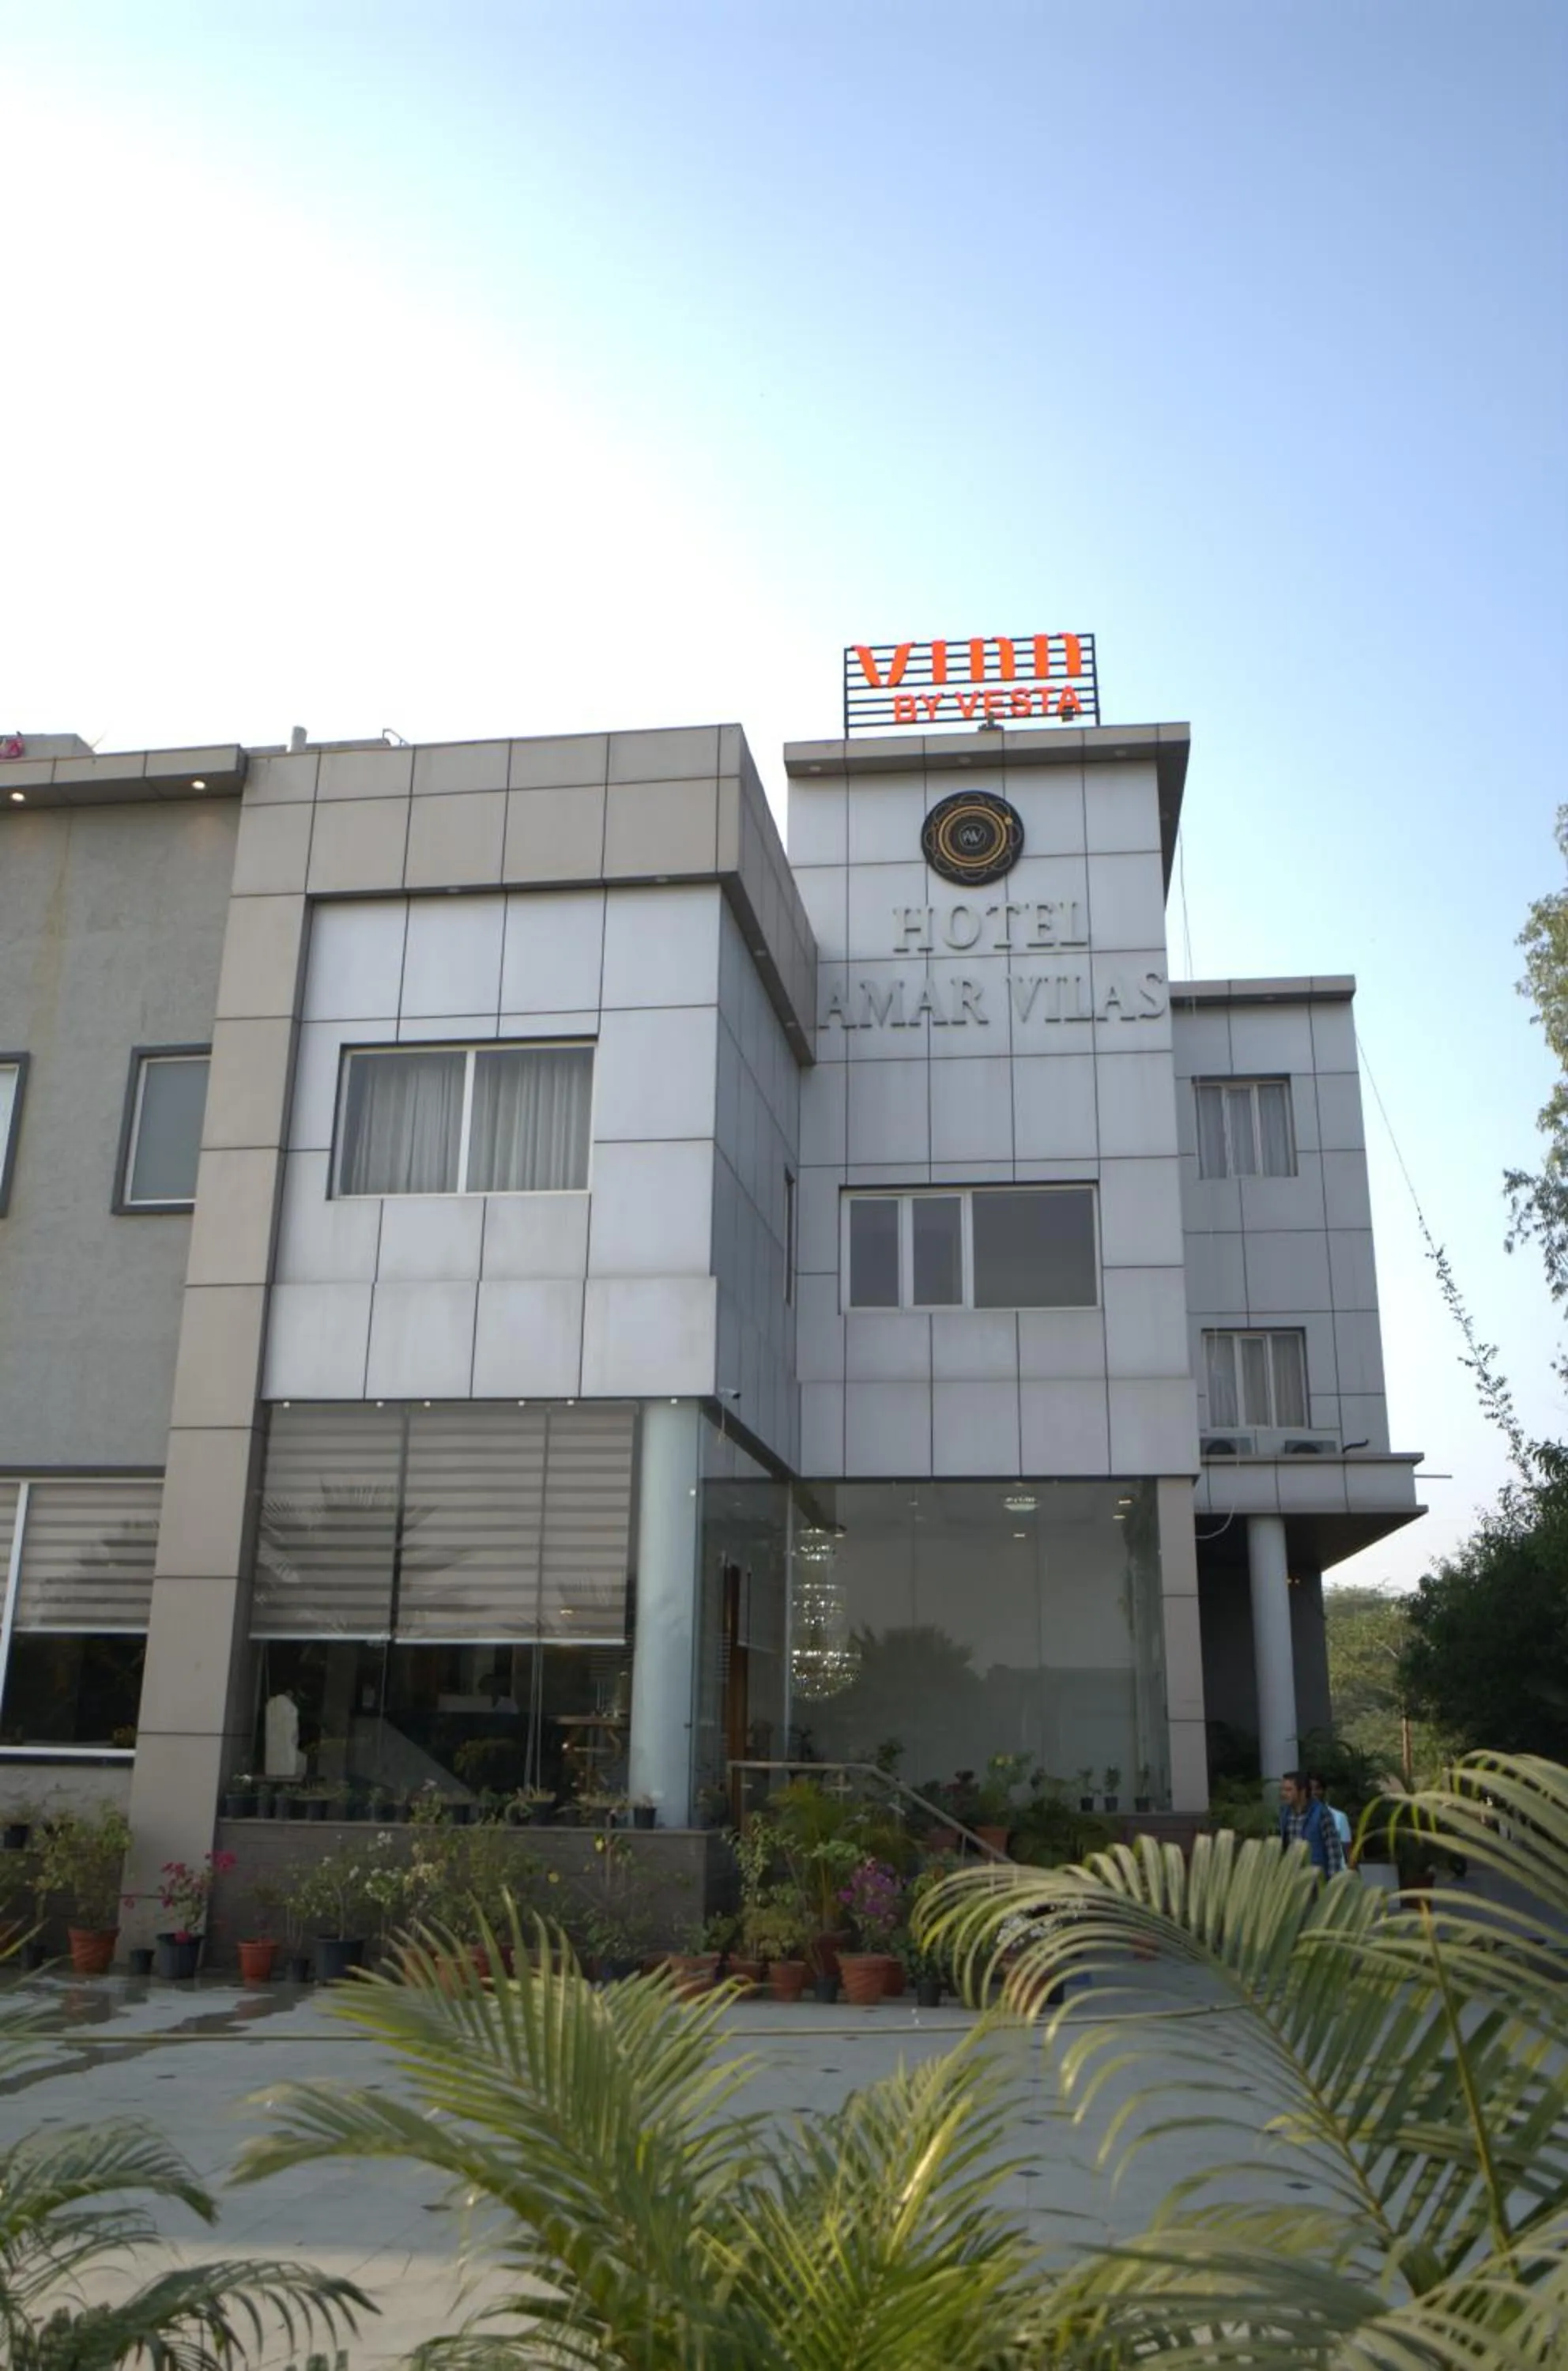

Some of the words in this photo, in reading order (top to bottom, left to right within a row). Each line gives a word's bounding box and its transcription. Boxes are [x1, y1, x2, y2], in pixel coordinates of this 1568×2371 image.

[893, 692, 944, 723] BY
[955, 685, 1084, 720] VESTA
[893, 902, 1088, 953] HOTEL
[816, 975, 989, 1030] AMAR
[1005, 973, 1167, 1024] VILAS
